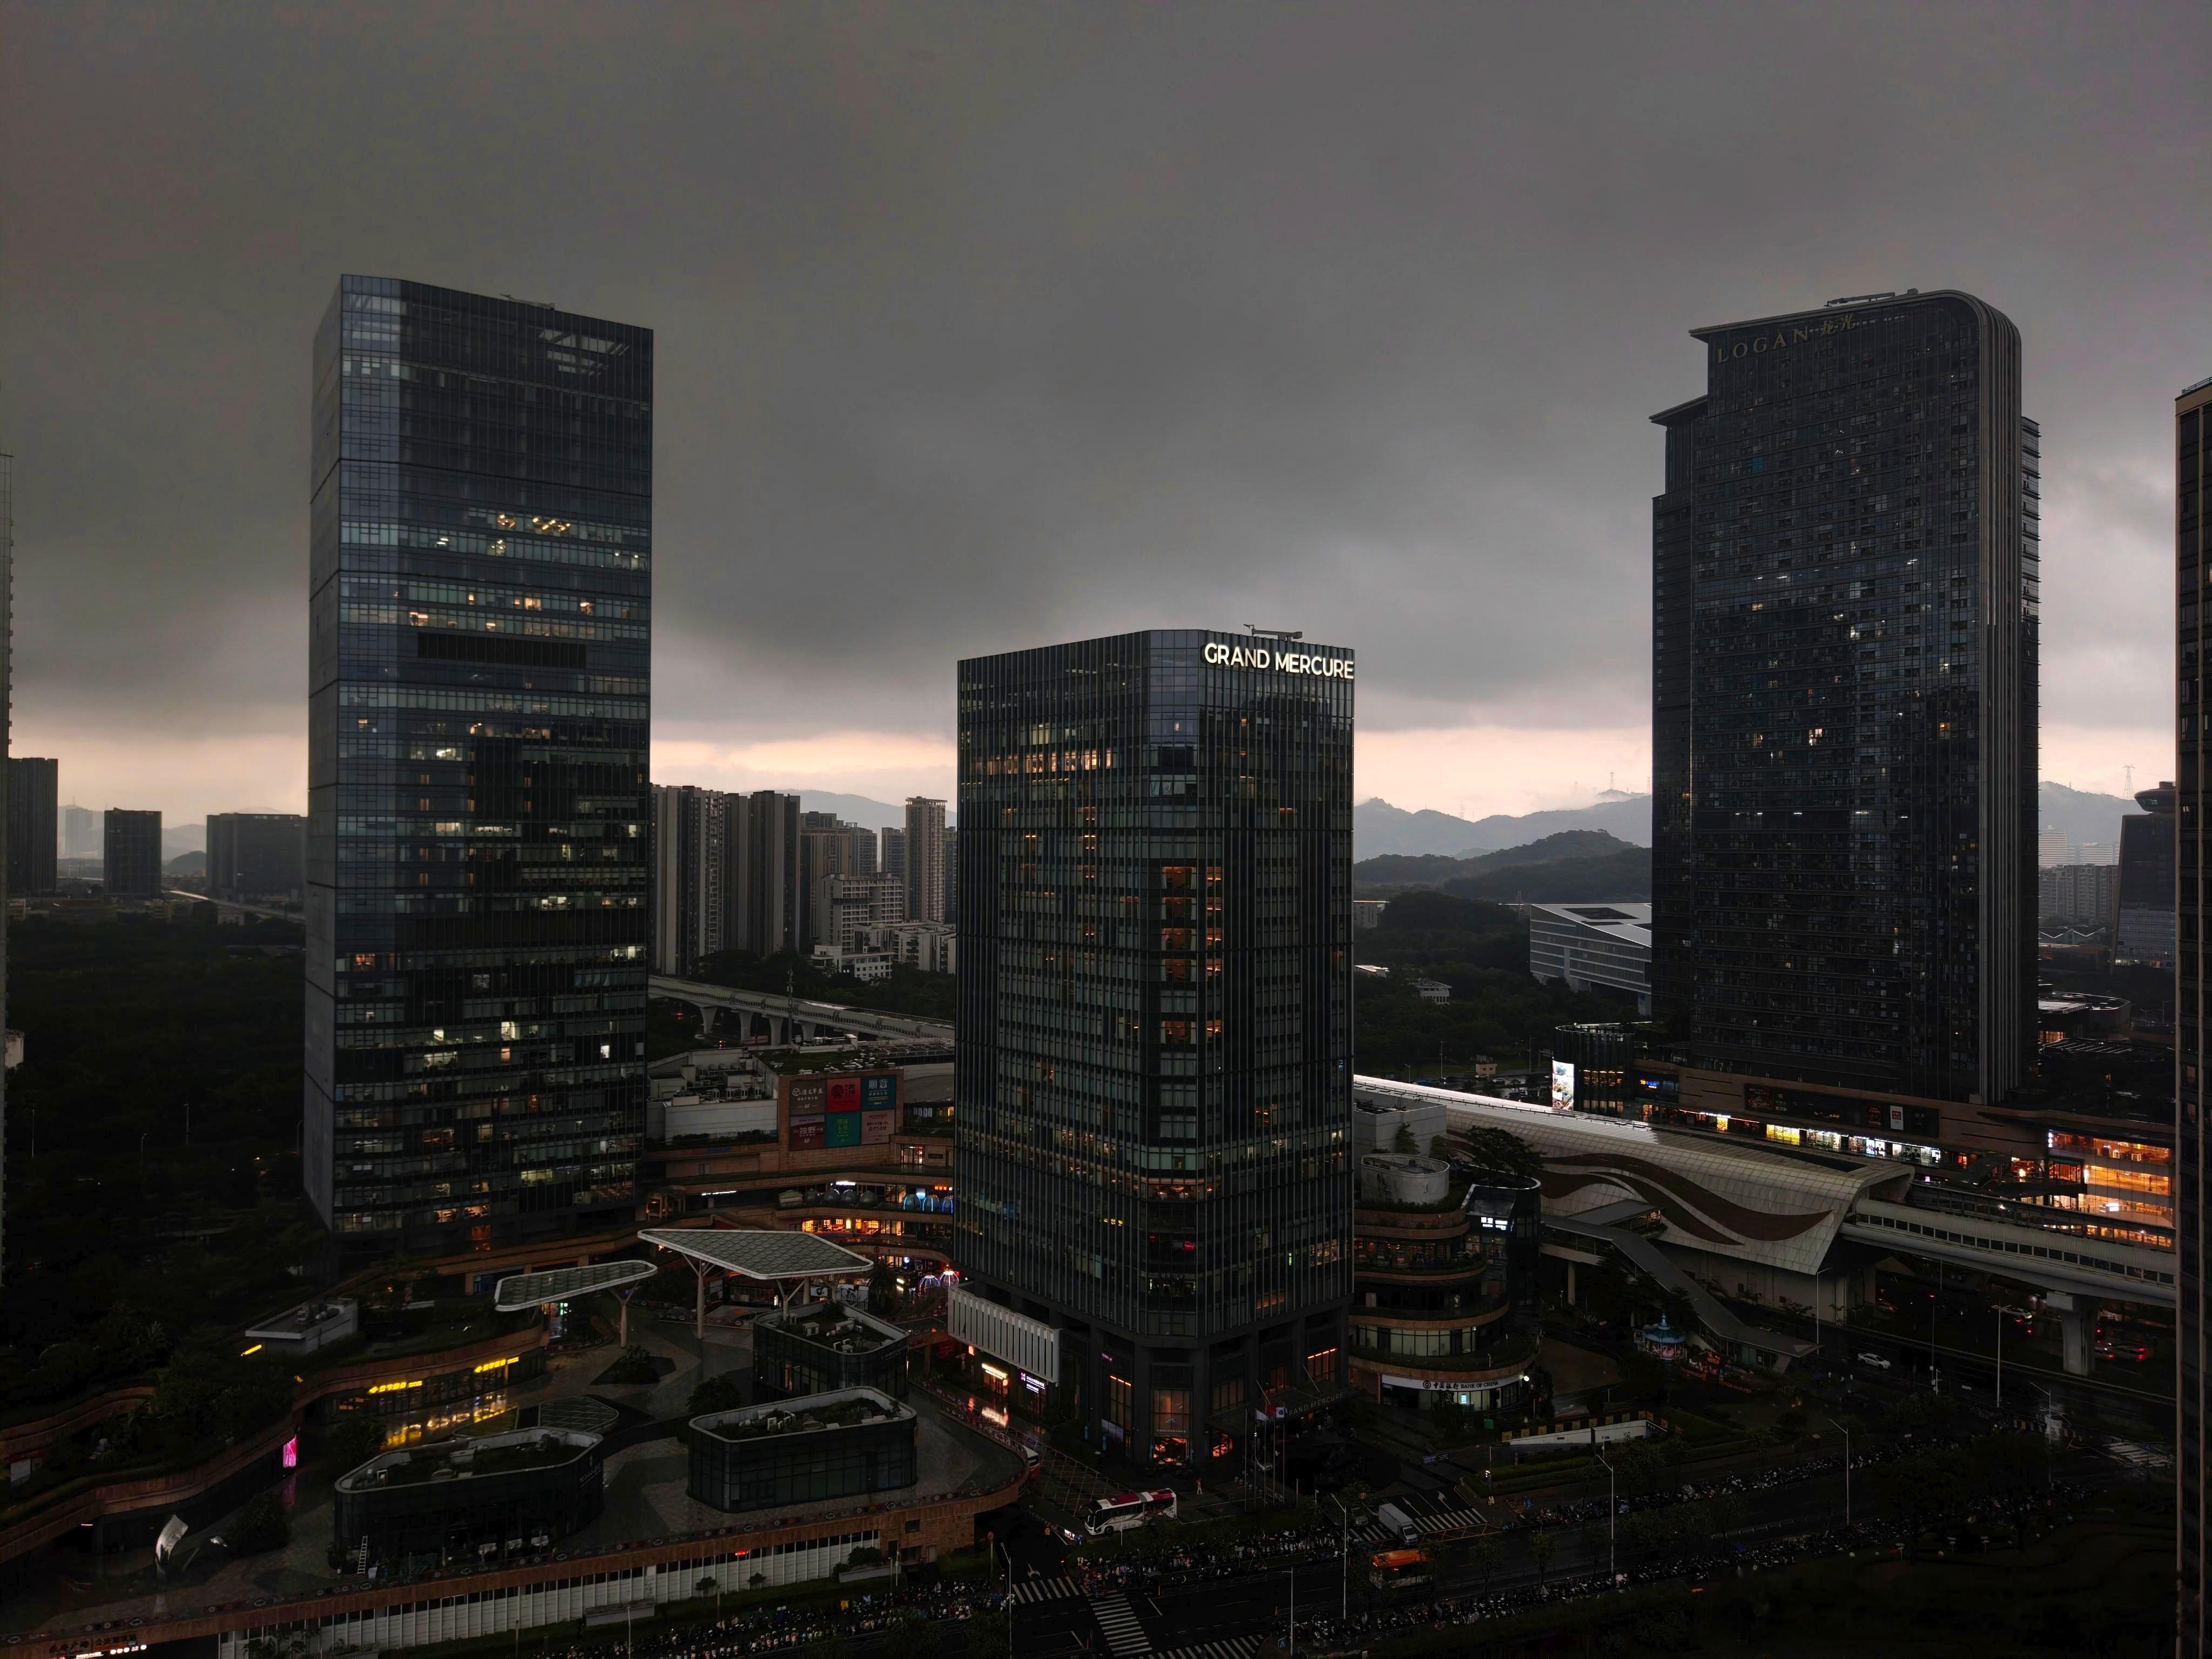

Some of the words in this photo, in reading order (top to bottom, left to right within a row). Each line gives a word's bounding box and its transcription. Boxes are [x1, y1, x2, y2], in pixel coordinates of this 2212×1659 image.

[1717, 326, 1809, 363] LOGAN
[1820, 314, 1856, 338] 龙光
[1204, 643, 1270, 669] GRAND
[1275, 652, 1354, 679] MERCURE
[1433, 1381, 1459, 1390] 中国银行
[1287, 1404, 1308, 1417] RAND
[1311, 1392, 1344, 1409] MERCURE
